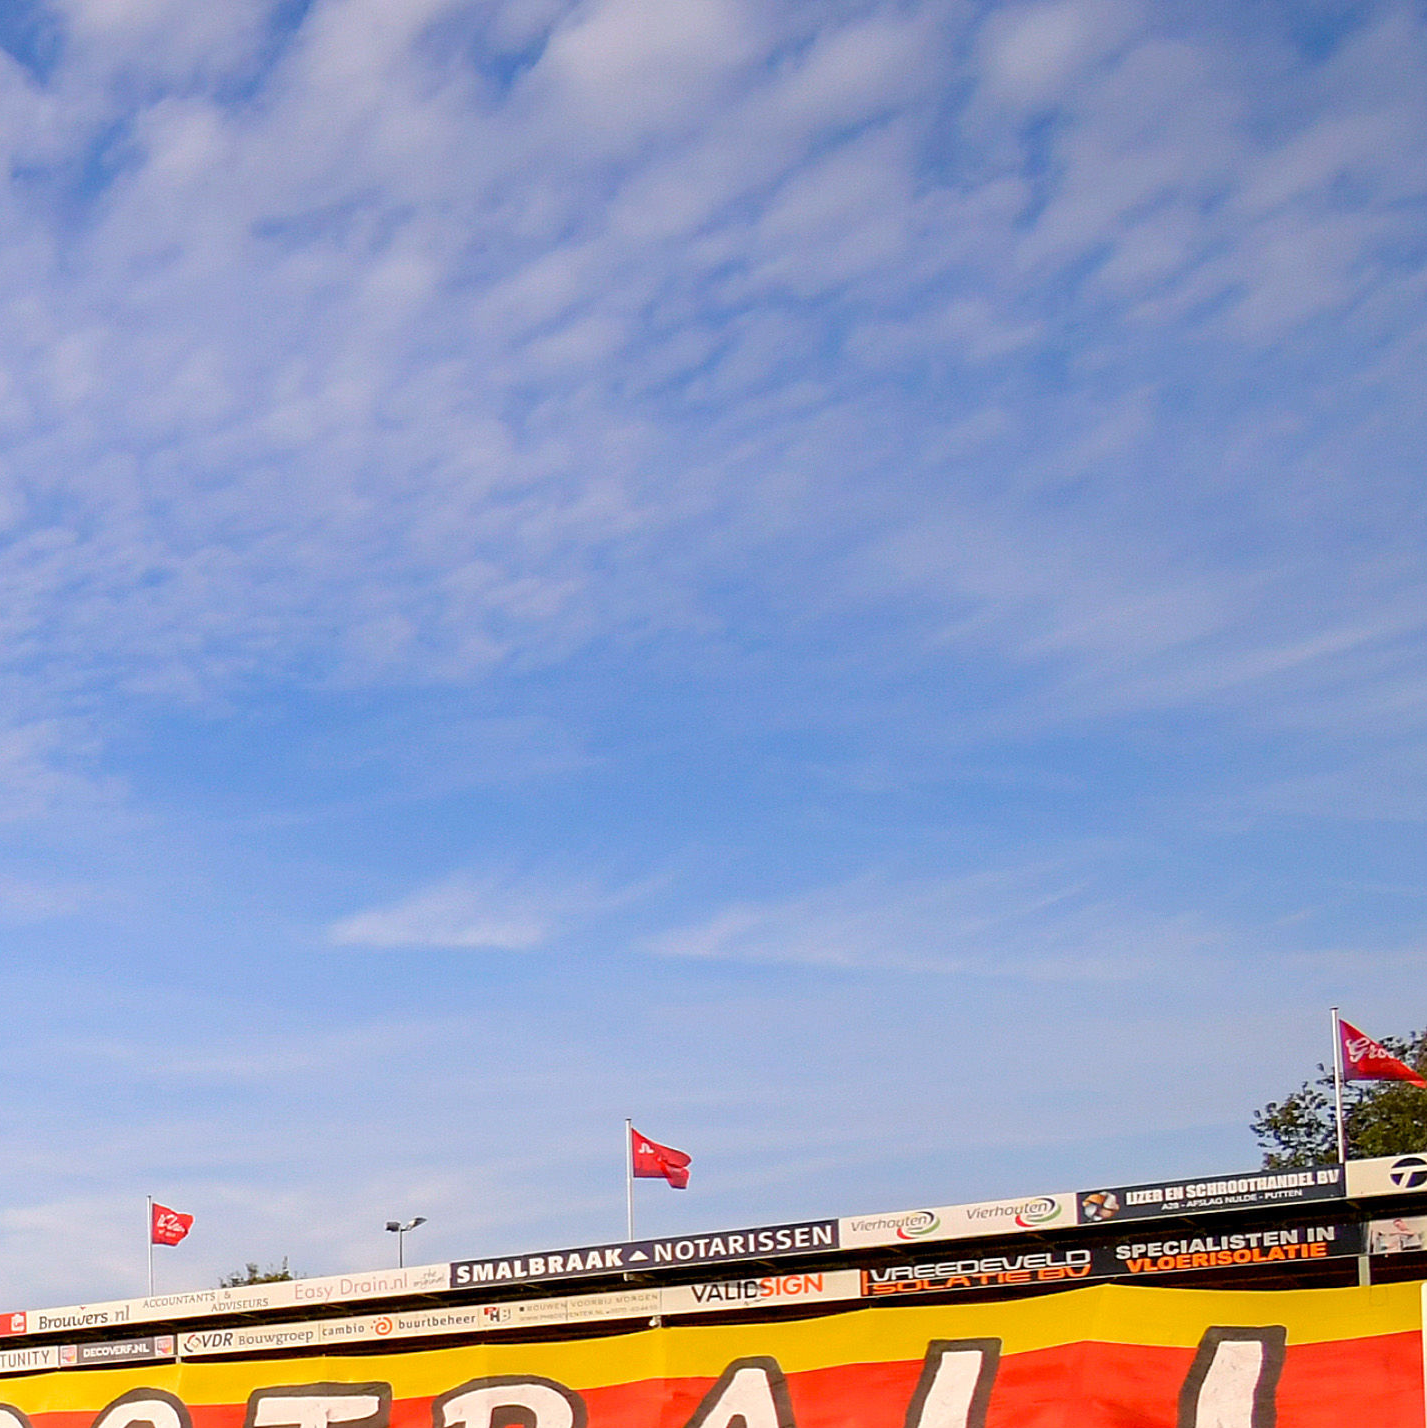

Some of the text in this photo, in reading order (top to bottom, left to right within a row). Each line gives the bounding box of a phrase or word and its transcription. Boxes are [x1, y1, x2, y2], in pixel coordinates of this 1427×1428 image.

[1165, 1185, 1184, 1202] EN
[1186, 1172, 1315, 1200] SCHROOTHANDEL
[1318, 1168, 1339, 1186] BV
[1187, 1198, 1222, 1209] AFSLAG
[1264, 1189, 1302, 1201] PUTTEN
[851, 1215, 928, 1232] Vierhouten
[966, 1202, 1047, 1220] Vierhouten
[457, 1225, 832, 1283] SMALBRAAK NOTARISSEN
[1115, 1225, 1335, 1260] SPECIALISTEN IN
[1125, 1241, 1327, 1274] VLOERISOLATIE
[862, 1265, 1091, 1295] ISOLATIE BV
[870, 1250, 1091, 1282] VREEDEVELD
[143, 1292, 215, 1308] ACCOUNTANTS
[295, 1274, 407, 1304] Easy Drain.nl
[691, 1274, 823, 1304] VALIDSIGN
[211, 1297, 268, 1312] ADVISEURS
[202, 1330, 313, 1347] VDR Bouwgroep
[322, 1314, 476, 1336] cambio buurtbeheer
